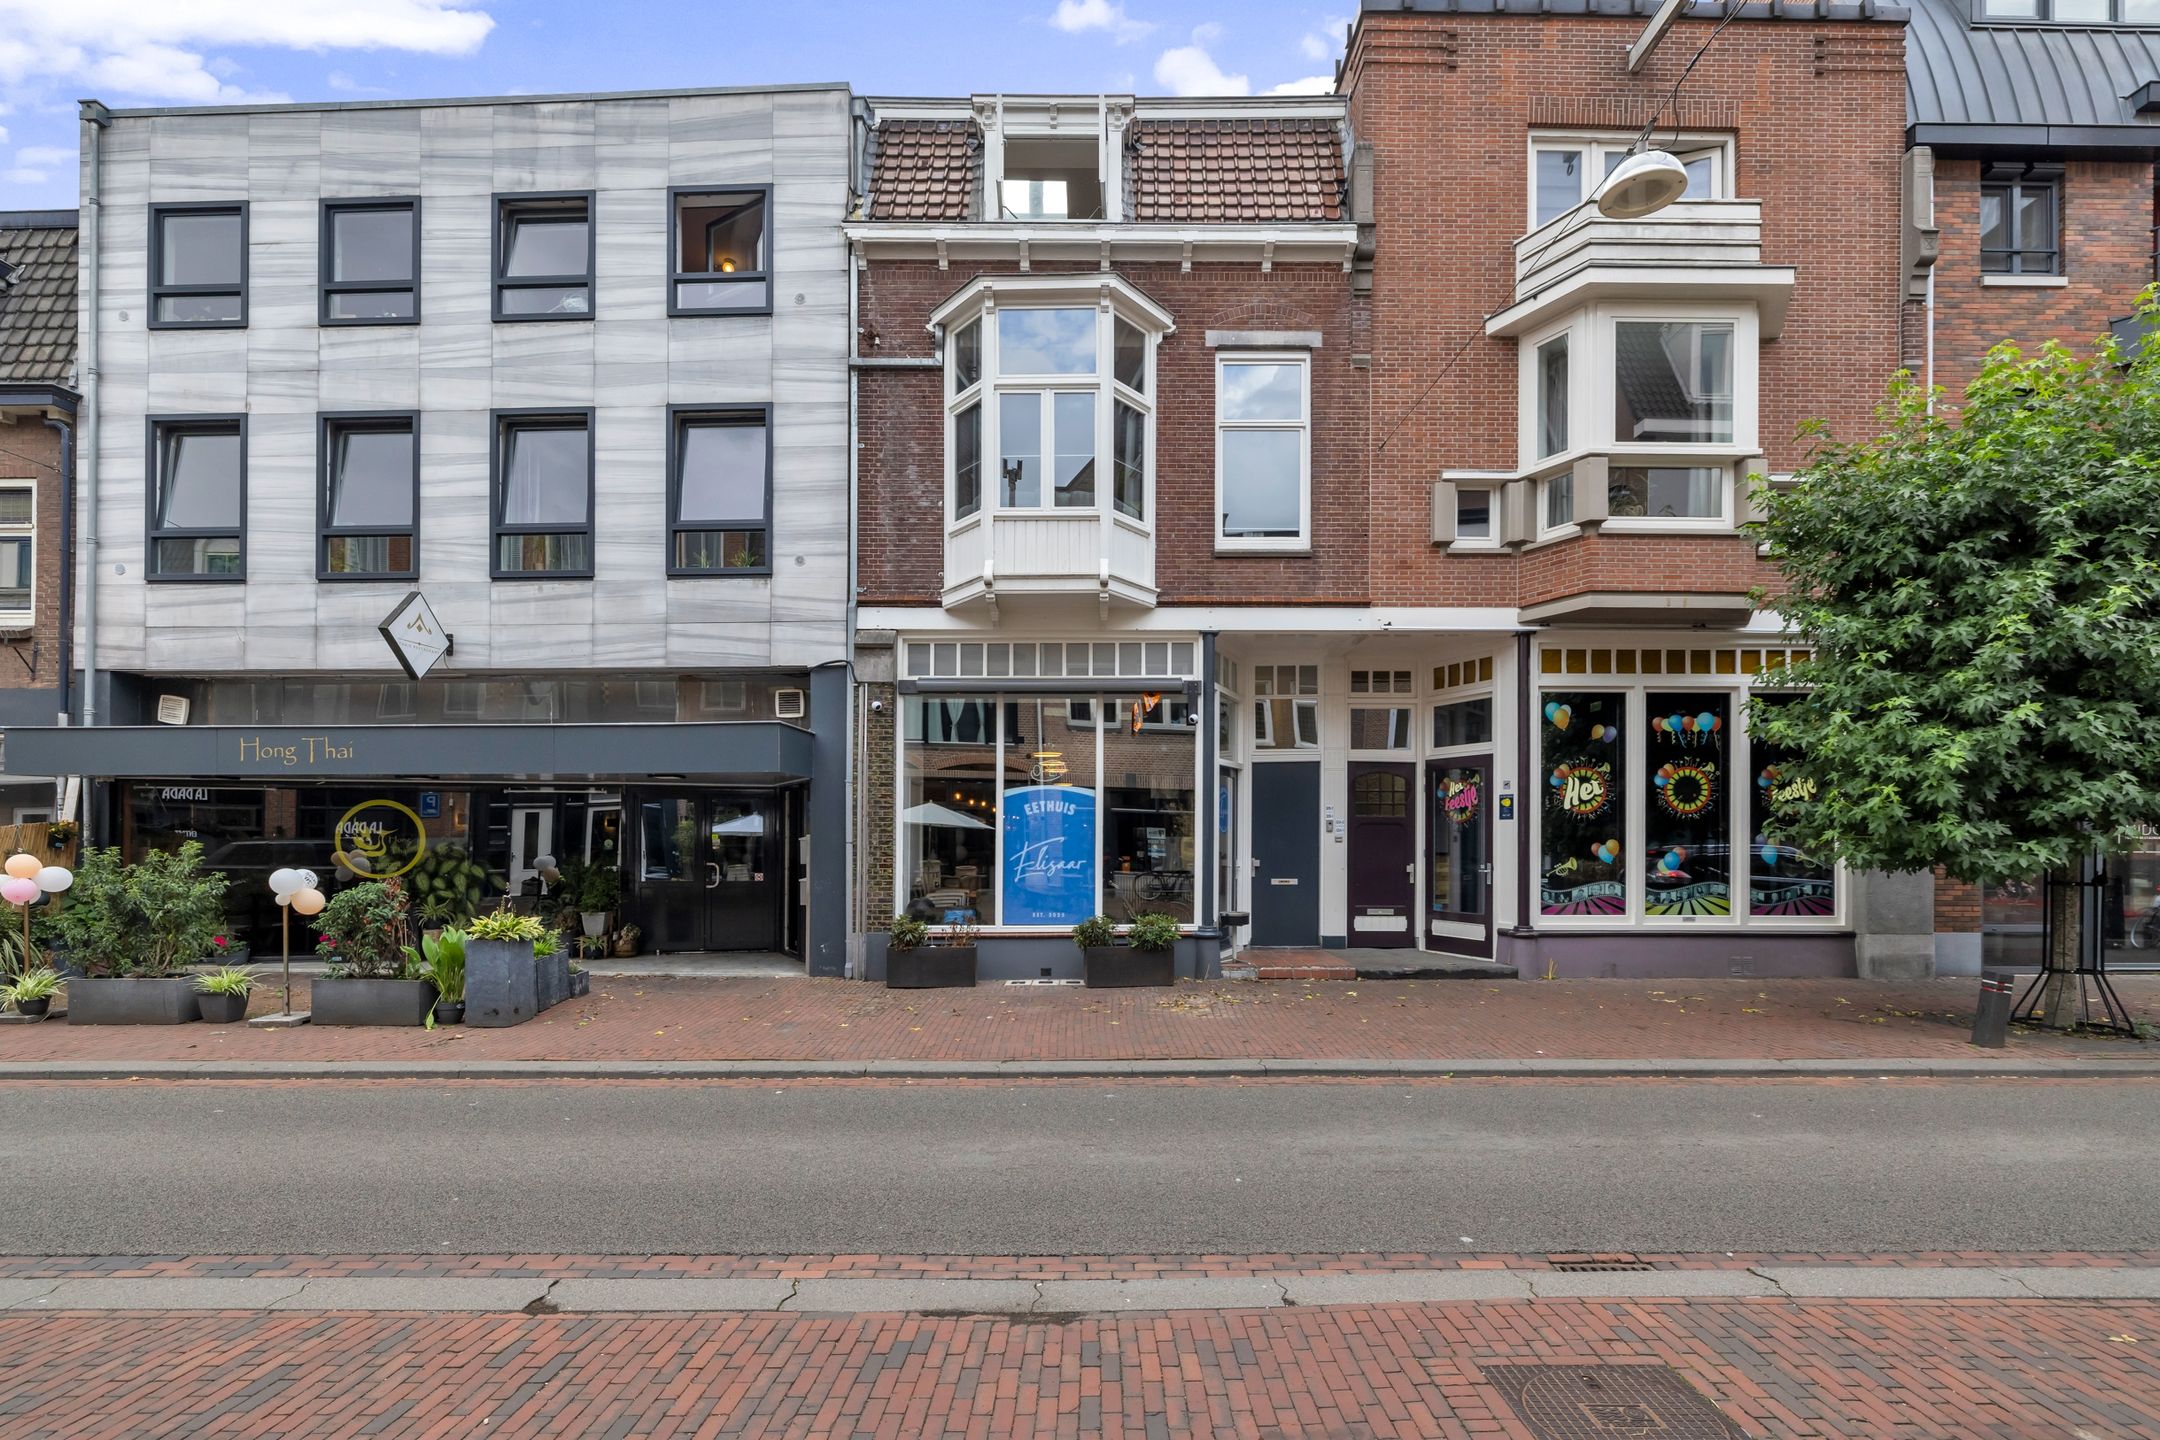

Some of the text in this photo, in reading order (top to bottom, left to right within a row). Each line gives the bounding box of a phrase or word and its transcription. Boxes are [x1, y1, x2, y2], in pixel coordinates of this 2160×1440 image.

[240, 736, 353, 766] Hong Thai
[1445, 783, 1478, 811] Feestje
[1449, 781, 1464, 797] Het
[1564, 776, 1604, 810] Het
[1024, 800, 1076, 816] EETHUIS
[1010, 837, 1087, 882] Elisaar
